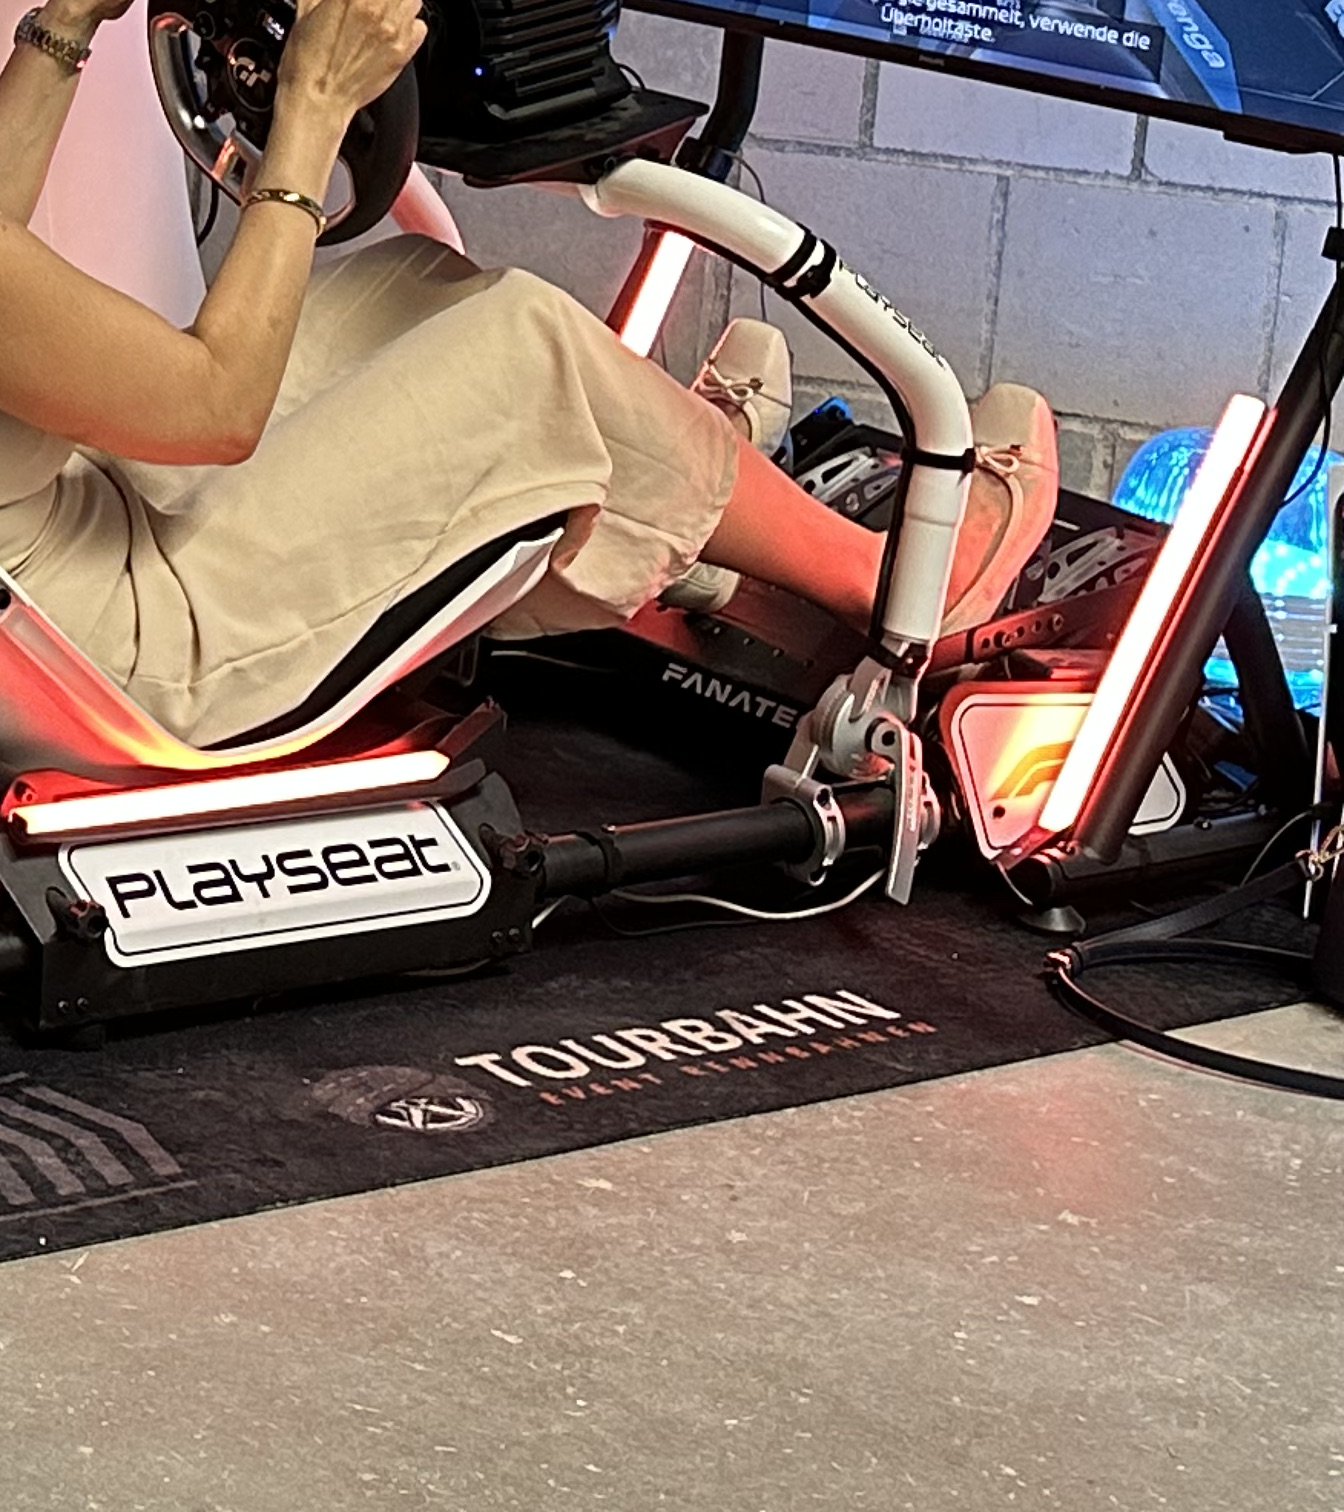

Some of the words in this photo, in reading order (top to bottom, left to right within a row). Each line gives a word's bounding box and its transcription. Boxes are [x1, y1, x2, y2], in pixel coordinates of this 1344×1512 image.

[1029, 13, 1118, 44] verwende
[1122, 30, 1151, 51] die
[661, 661, 799, 730] FANATE
[454, 989, 902, 1088] TOURBAHN
[538, 1070, 664, 1107] EVENT
[680, 1019, 938, 1078] RENNBAHNEN
